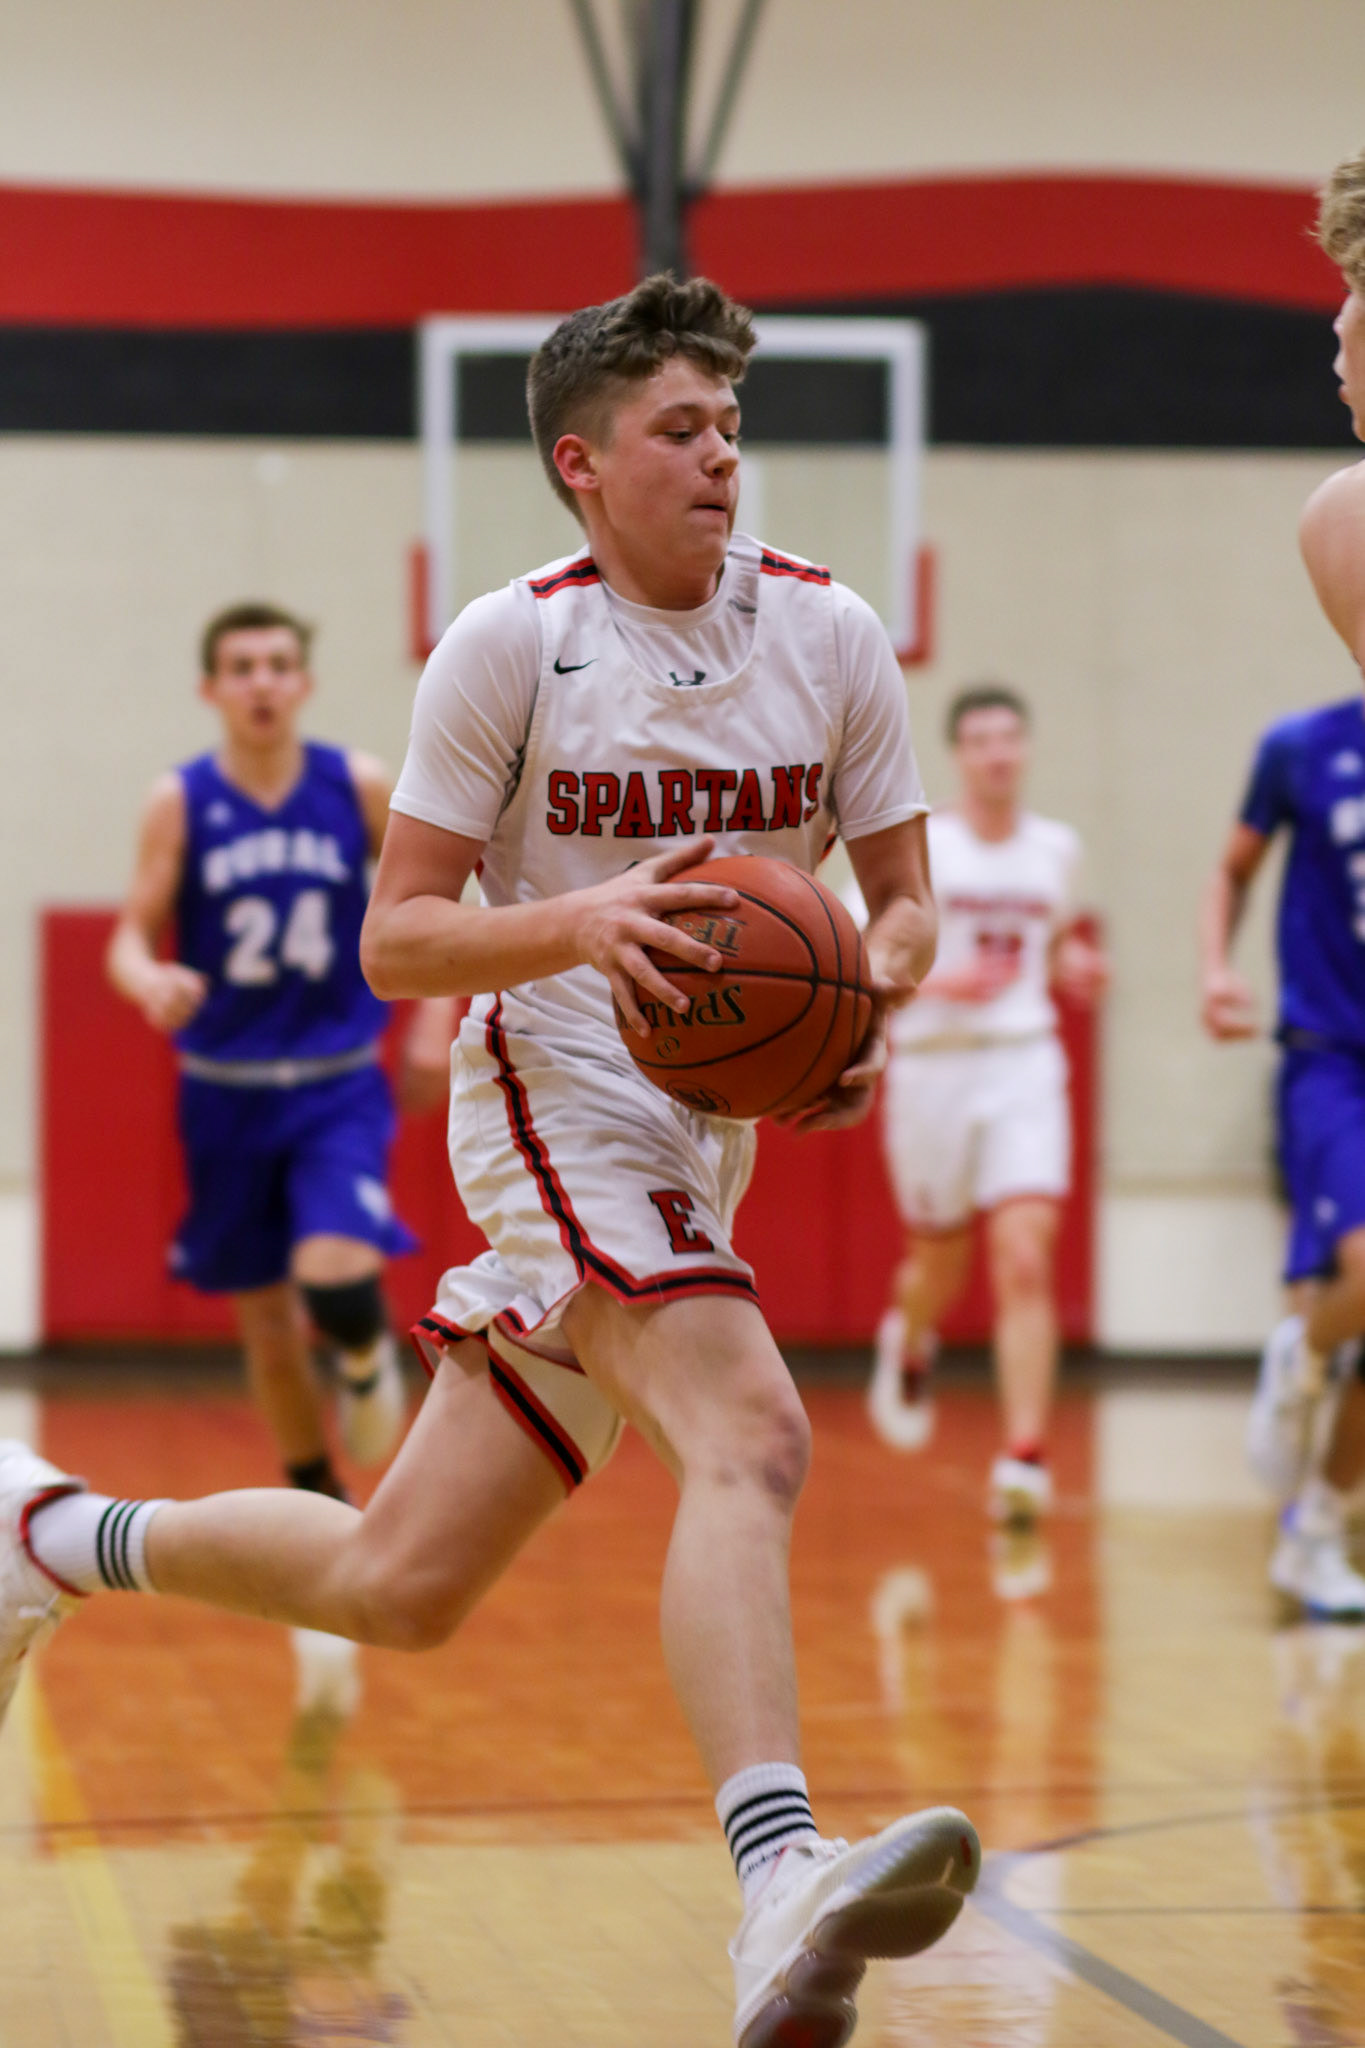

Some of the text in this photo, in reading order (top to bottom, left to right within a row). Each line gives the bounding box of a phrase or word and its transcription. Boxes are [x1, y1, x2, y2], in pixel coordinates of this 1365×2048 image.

[546, 763, 824, 838] SPARTANS
[225, 889, 335, 984] 24
[615, 984, 747, 1030] SPALD
[647, 1187, 715, 1256] E
